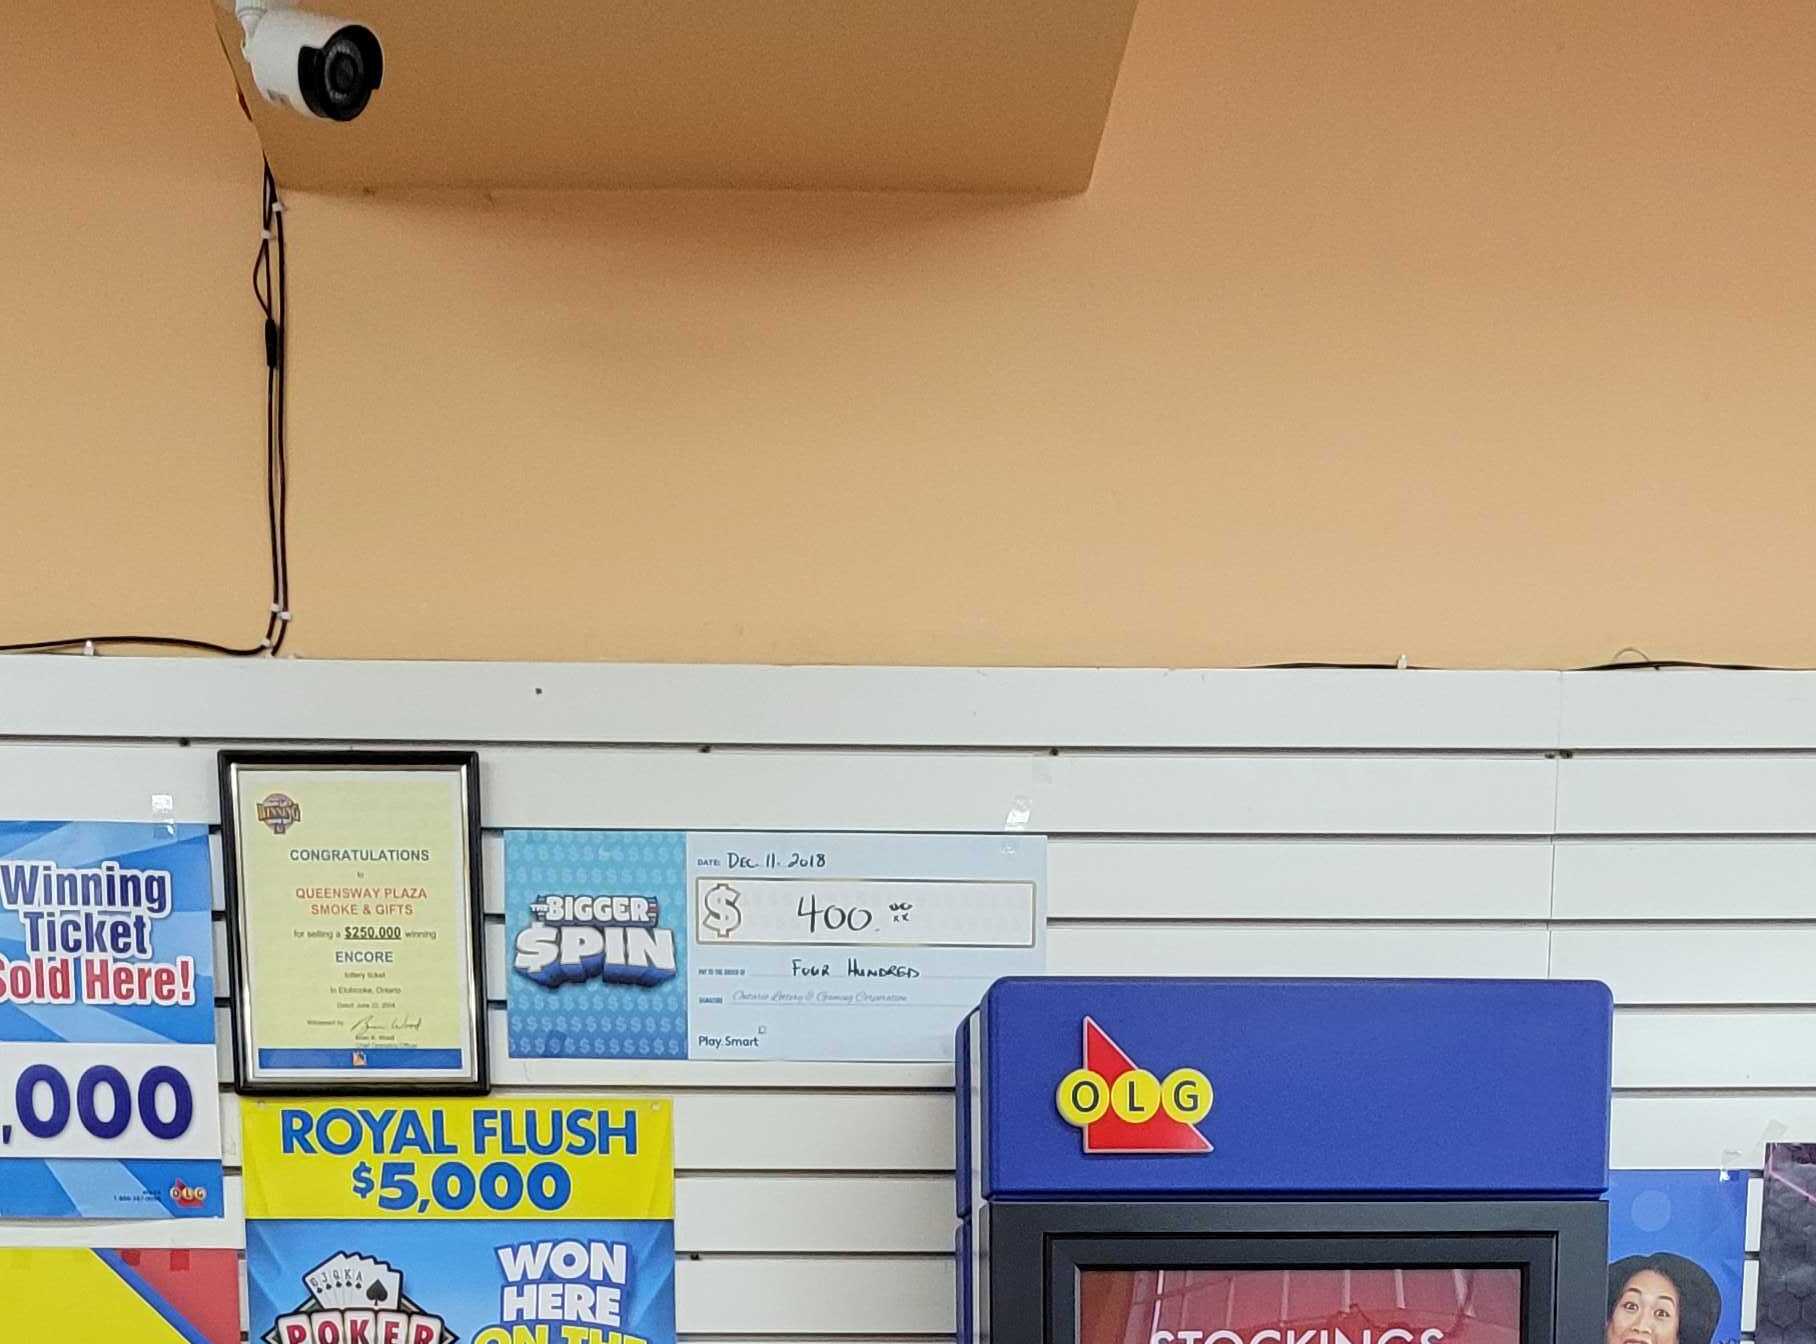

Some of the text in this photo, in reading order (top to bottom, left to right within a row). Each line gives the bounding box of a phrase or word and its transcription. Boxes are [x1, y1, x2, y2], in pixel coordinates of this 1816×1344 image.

[290, 850, 429, 861] CONGRATULATIONS
[788, 853, 826, 868] 2018
[2, 866, 167, 913] Winning
[296, 888, 427, 899] QUEENSWAY PLAZA
[311, 904, 413, 915] SMOKE & GIFTS
[546, 896, 650, 923] BIGGER
[24, 913, 146, 955] Ticket
[335, 951, 393, 962] ENCORE
[86, 959, 191, 1001] Here!
[698, 1036, 759, 1049] Play Smart
[1071, 1080, 1200, 1113] OLG
[281, 1108, 638, 1155] ROYAL FLUSH
[352, 1161, 572, 1213] $5,000
[499, 1241, 627, 1285] WON
[503, 1285, 621, 1327] HERE
